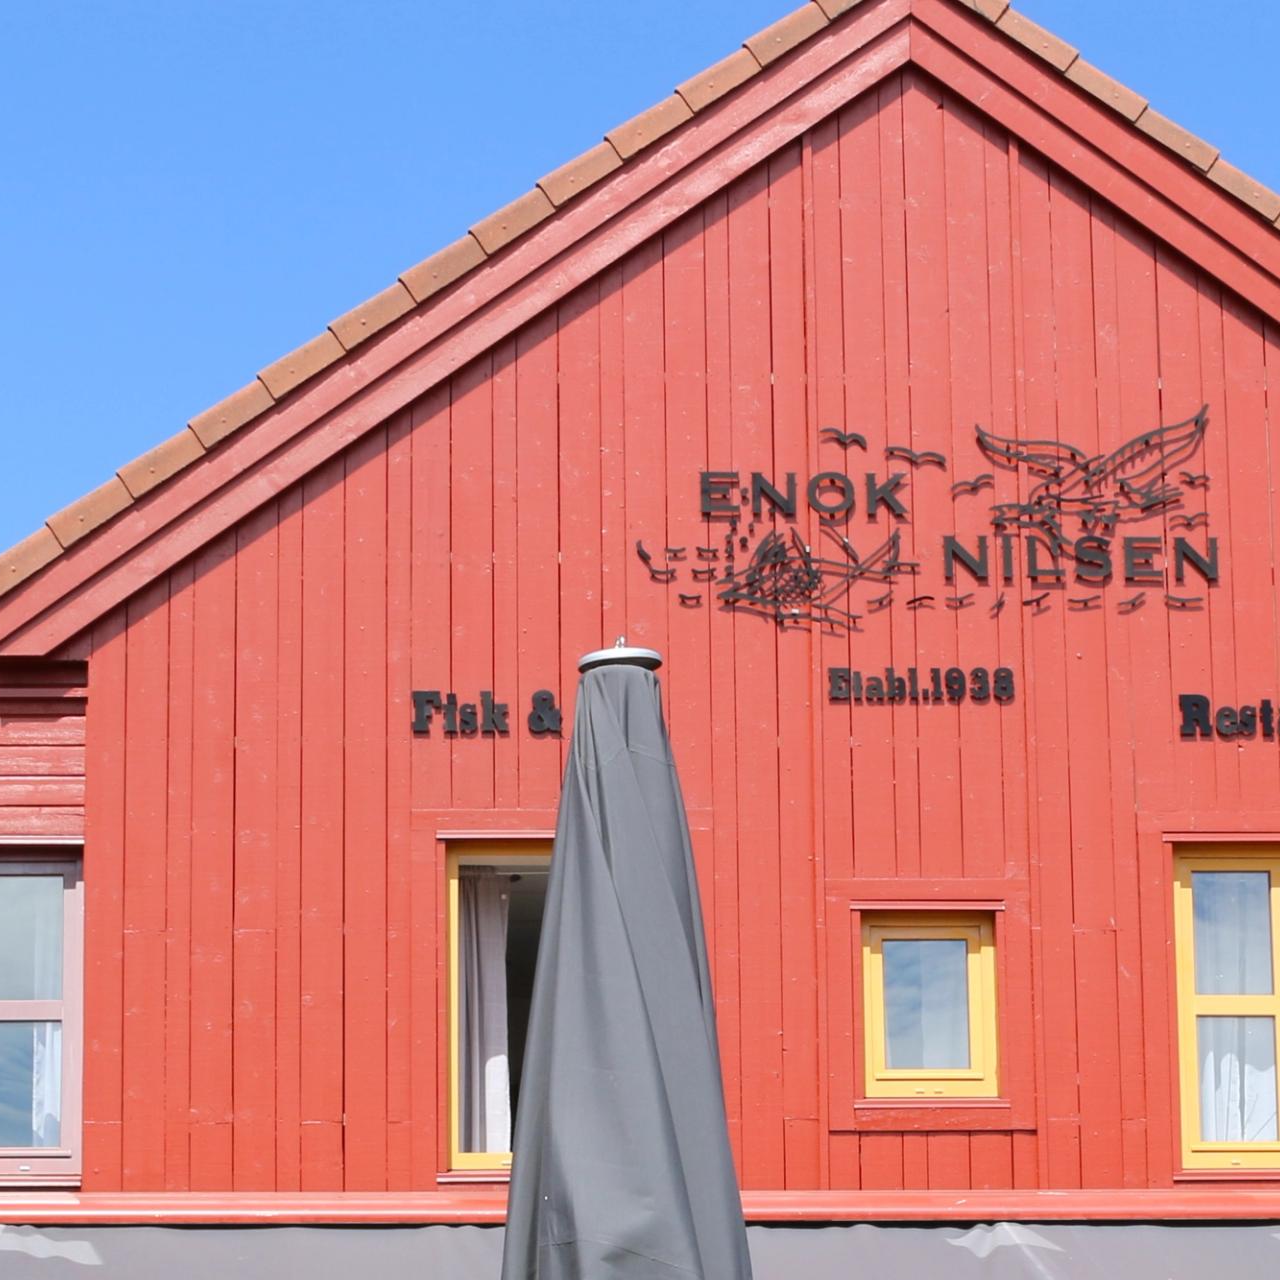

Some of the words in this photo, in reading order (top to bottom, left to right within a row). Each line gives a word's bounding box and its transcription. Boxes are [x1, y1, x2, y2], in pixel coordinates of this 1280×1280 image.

[700, 471, 909, 521] ENOK
[943, 535, 1220, 587] NILSEN
[412, 690, 510, 736] Fisk
[528, 689, 563, 736] &
